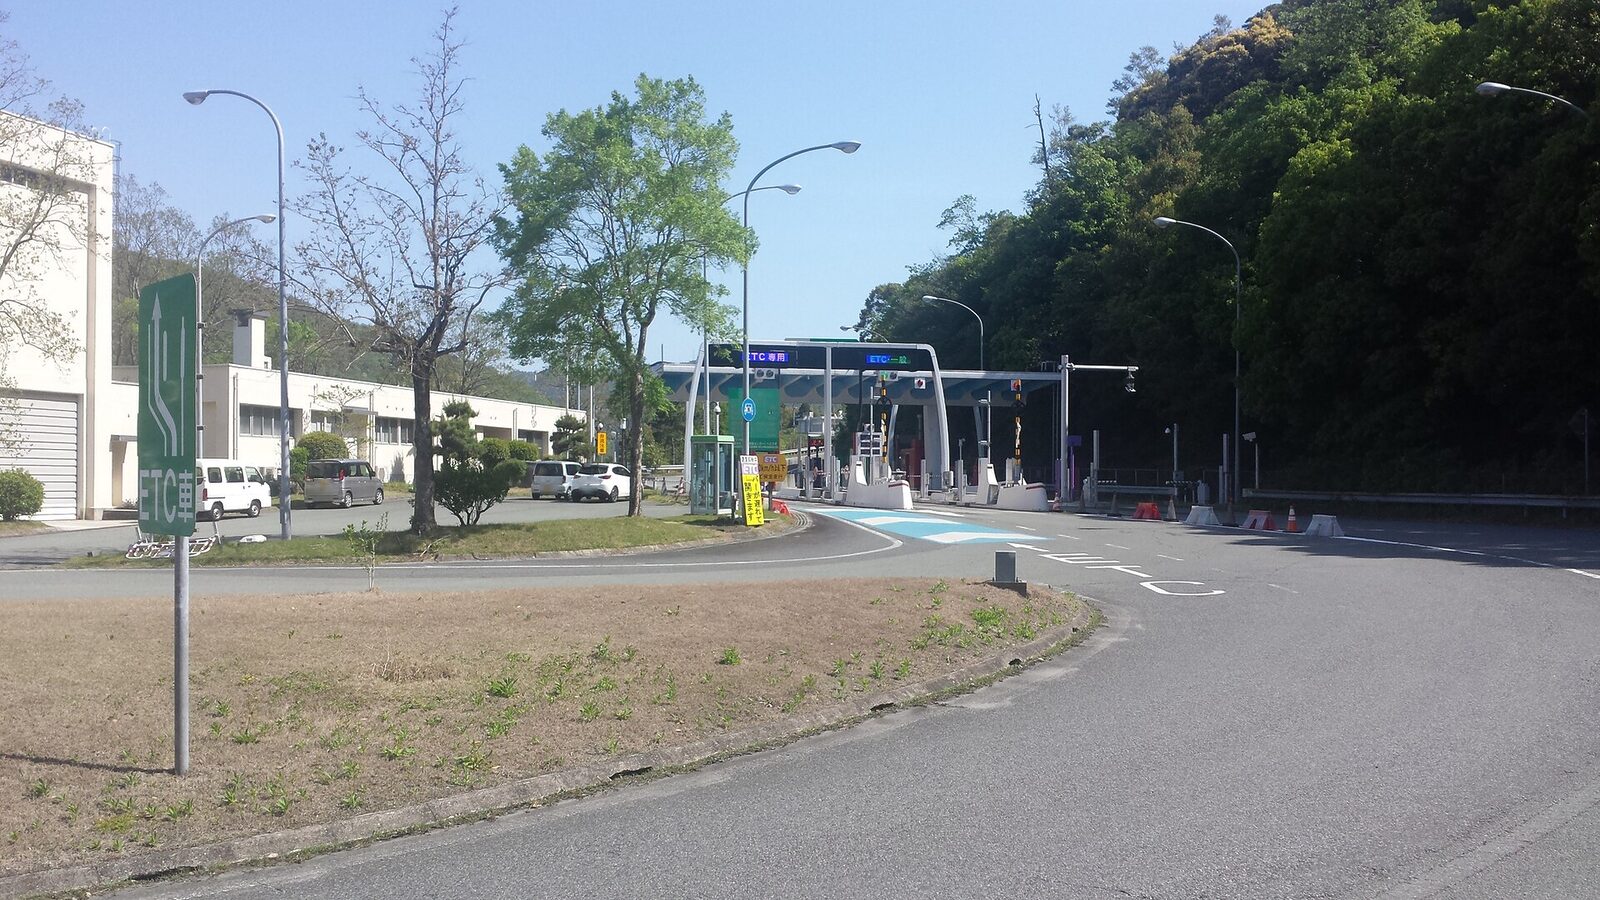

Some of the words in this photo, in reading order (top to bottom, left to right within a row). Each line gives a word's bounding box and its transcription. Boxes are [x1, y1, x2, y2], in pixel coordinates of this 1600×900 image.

[768, 353, 785, 362] 専用
[139, 468, 194, 523] ETC車
[744, 482, 754, 521] 開きます
[1038, 553, 1226, 596] ETC
